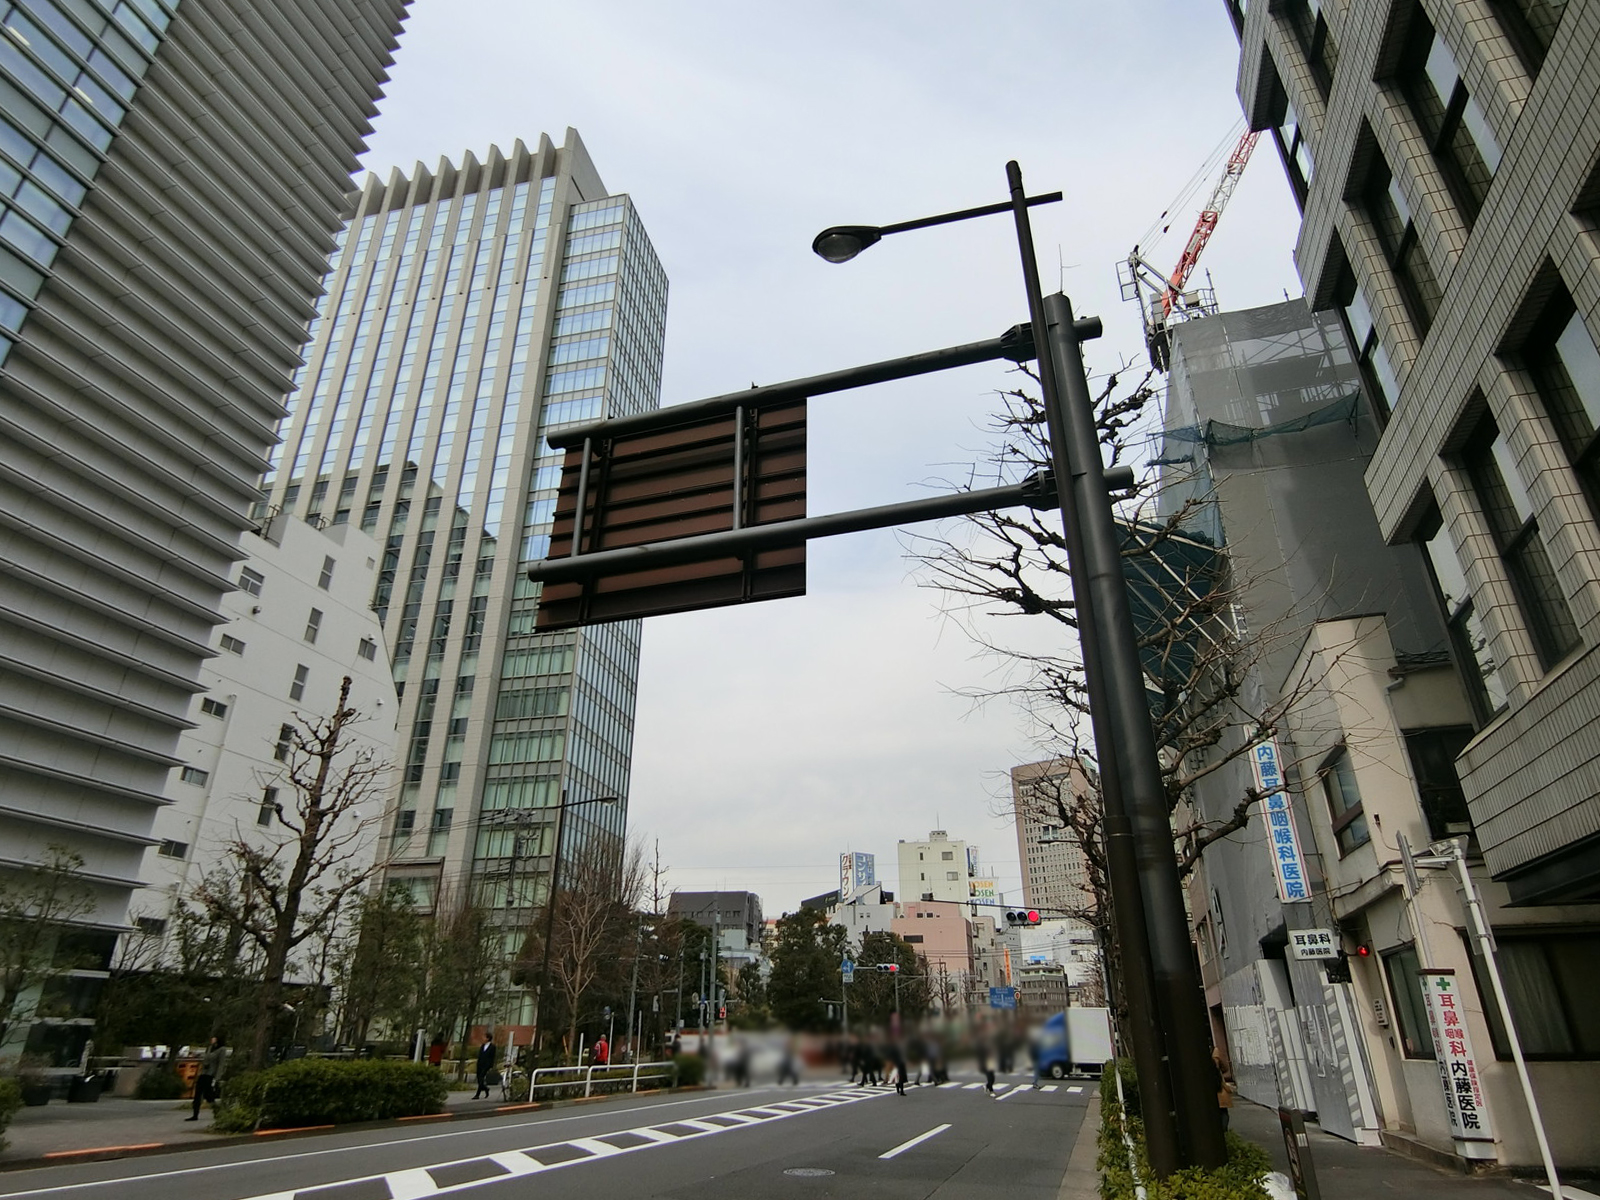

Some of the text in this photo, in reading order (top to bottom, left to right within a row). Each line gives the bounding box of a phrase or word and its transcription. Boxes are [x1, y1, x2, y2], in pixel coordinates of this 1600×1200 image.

[1294, 933, 1331, 946] 耳鼻科
[1300, 947, 1331, 956] 内藤医院
[1451, 1060, 1481, 1130] 内藤医院
